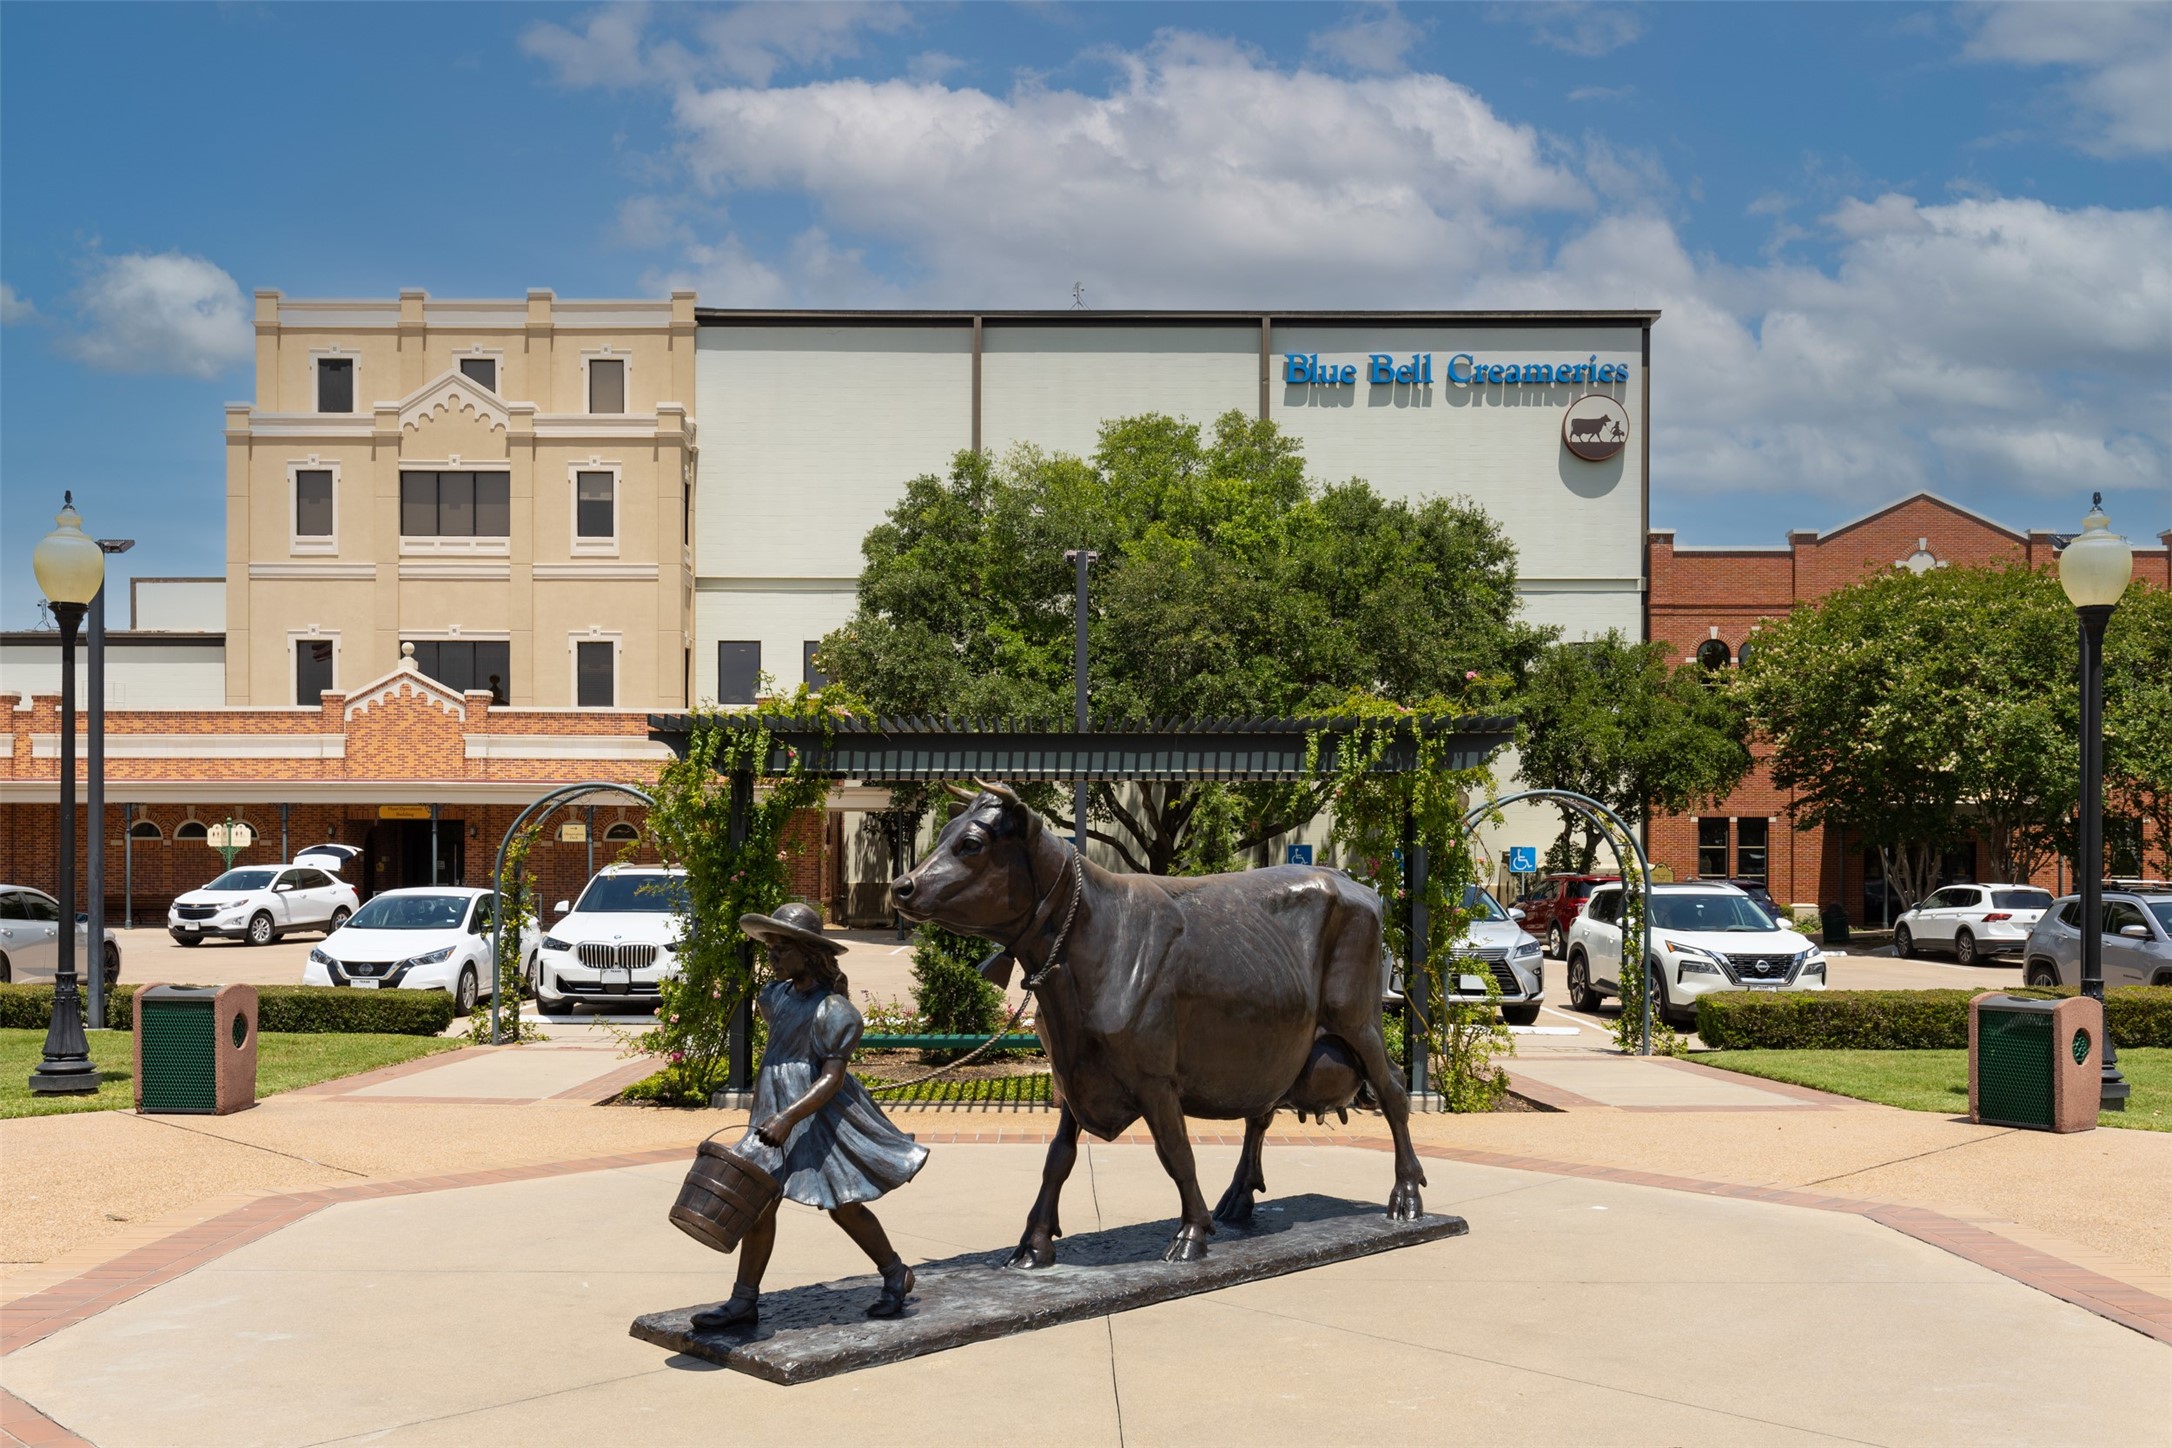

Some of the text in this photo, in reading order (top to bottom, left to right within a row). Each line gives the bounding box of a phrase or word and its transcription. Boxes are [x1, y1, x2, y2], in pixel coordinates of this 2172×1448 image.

[1285, 353, 1629, 384] Blue Bell Creameries
